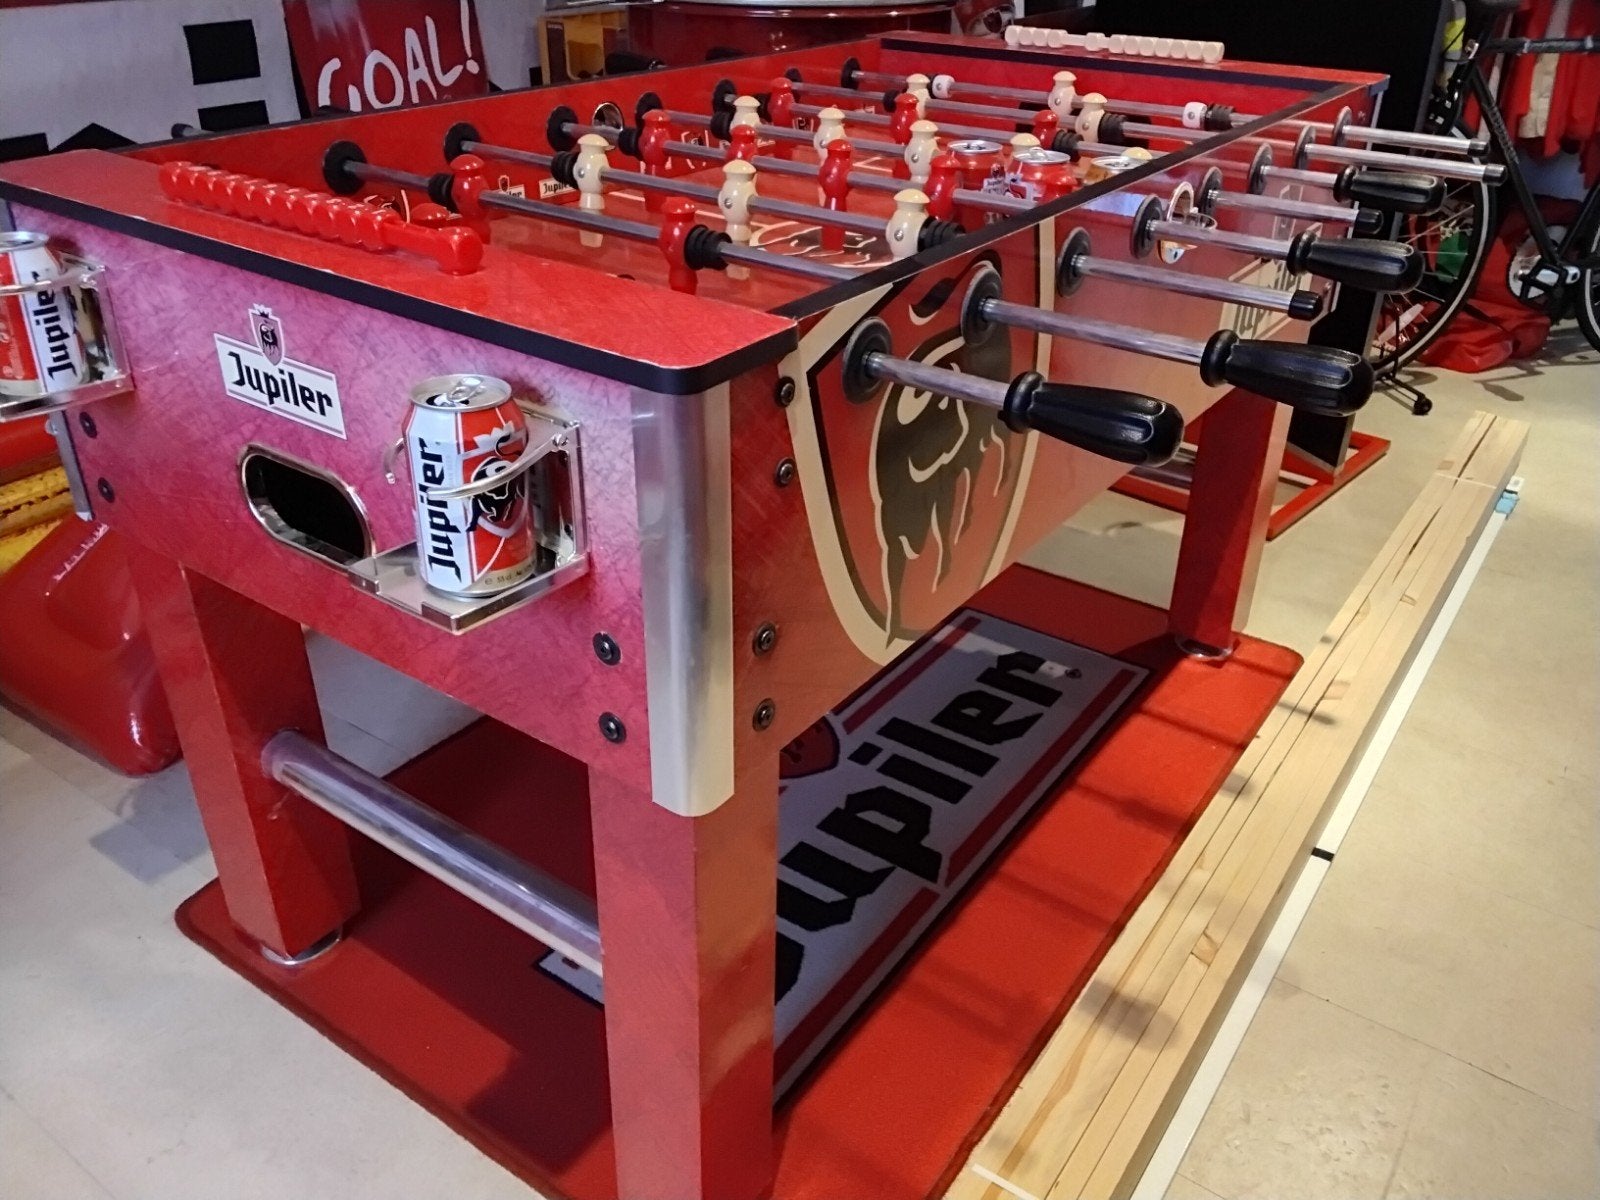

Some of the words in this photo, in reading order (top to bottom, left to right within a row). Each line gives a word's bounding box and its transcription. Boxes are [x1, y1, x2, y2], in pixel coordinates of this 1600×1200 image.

[317, 0, 480, 112] GOAL!
[227, 351, 333, 417] Jupiler
[775, 651, 1064, 1006] upiler
